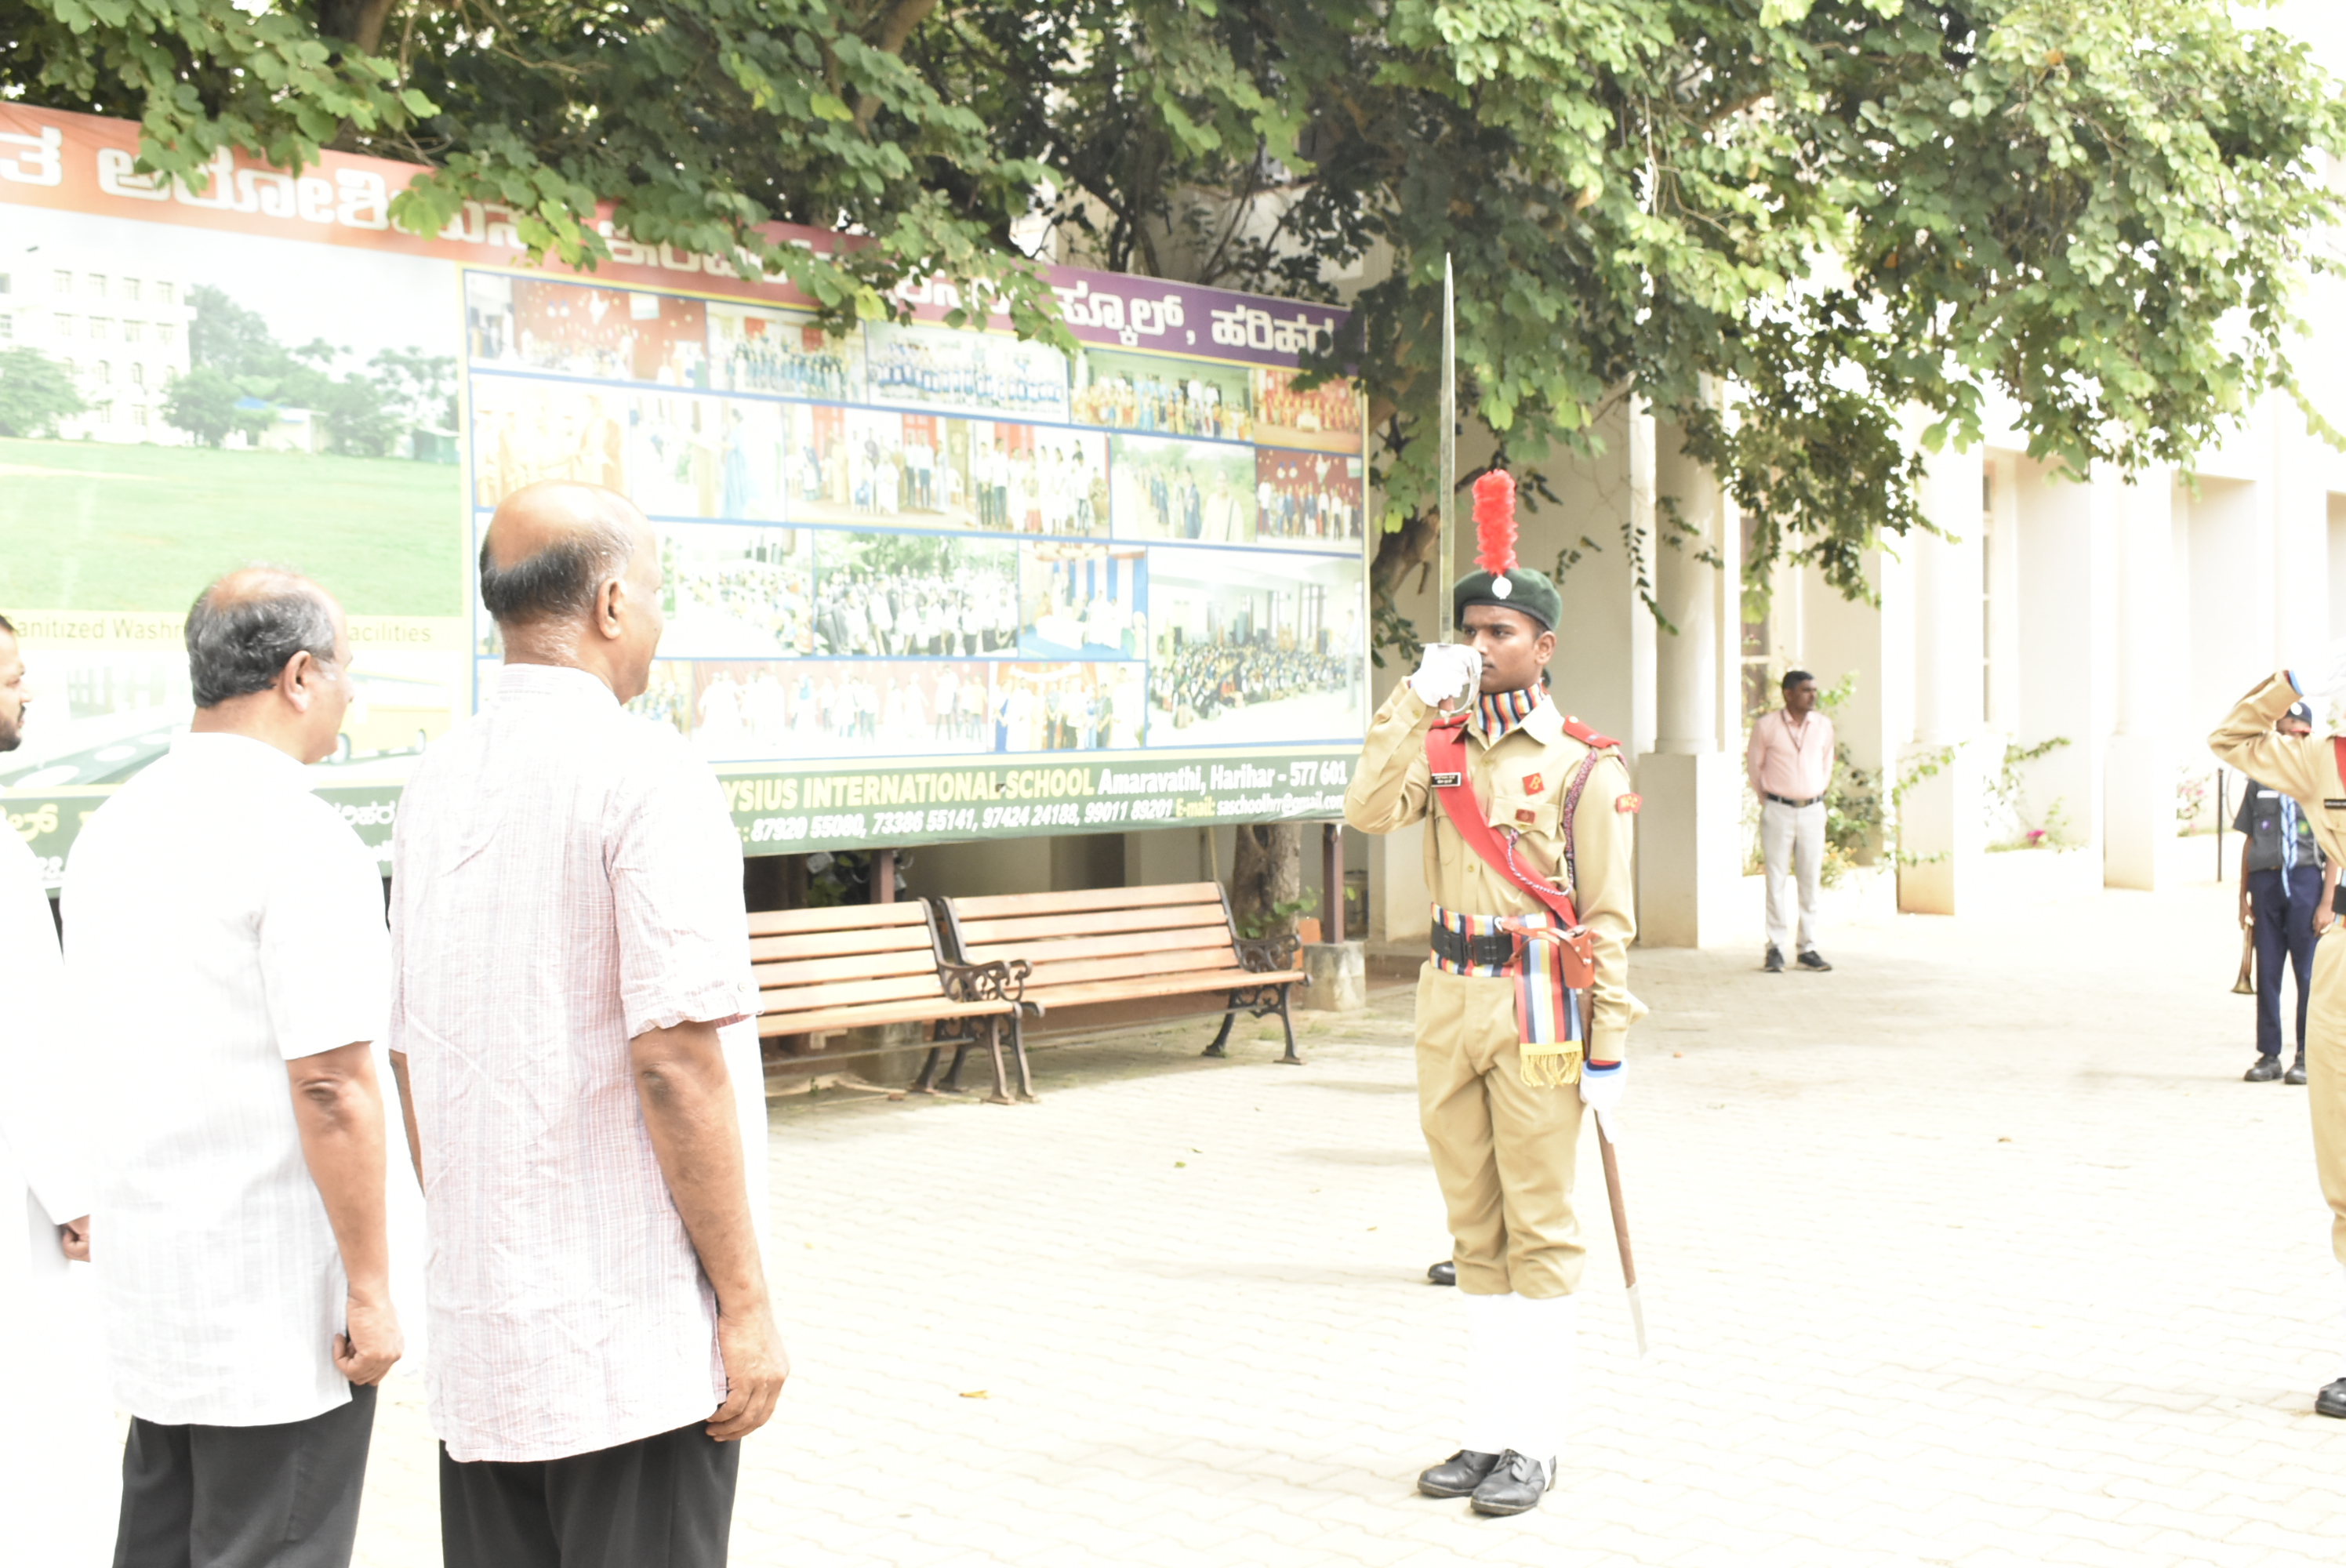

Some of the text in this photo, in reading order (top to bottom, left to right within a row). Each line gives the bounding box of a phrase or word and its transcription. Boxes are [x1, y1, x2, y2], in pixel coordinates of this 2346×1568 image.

[802, 771, 1002, 809] INTERNATIONAL
[1005, 768, 1095, 800] SCHOOL
[1098, 765, 1206, 796] Amaravathi,
[1210, 763, 1276, 790] Harihar
[1290, 761, 1319, 786] 577
[1320, 760, 1348, 786] 601
[750, 815, 808, 842] 87920
[872, 810, 924, 835] 73386
[926, 808, 979, 832] 55141,
[982, 805, 1030, 829] 97424
[1031, 803, 1080, 826] 24188,
[1084, 800, 1129, 823] 99011
[1131, 798, 1174, 821] 89201
